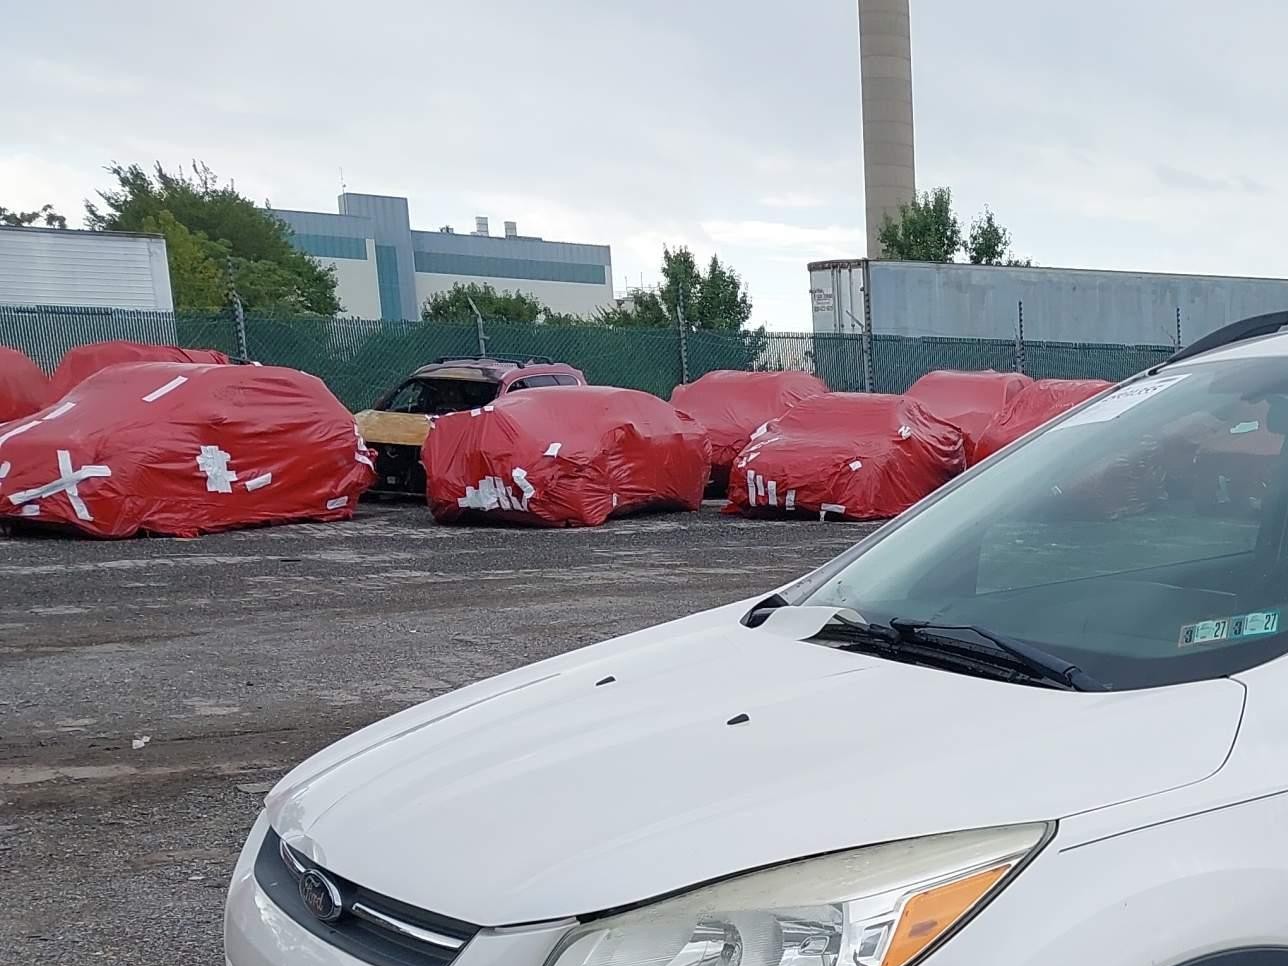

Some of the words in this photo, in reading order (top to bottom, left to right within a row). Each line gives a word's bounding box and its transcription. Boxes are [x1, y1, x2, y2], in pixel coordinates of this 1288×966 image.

[1214, 621, 1226, 638] 27
[1264, 613, 1277, 631] 27
[303, 875, 325, 911] Ford
